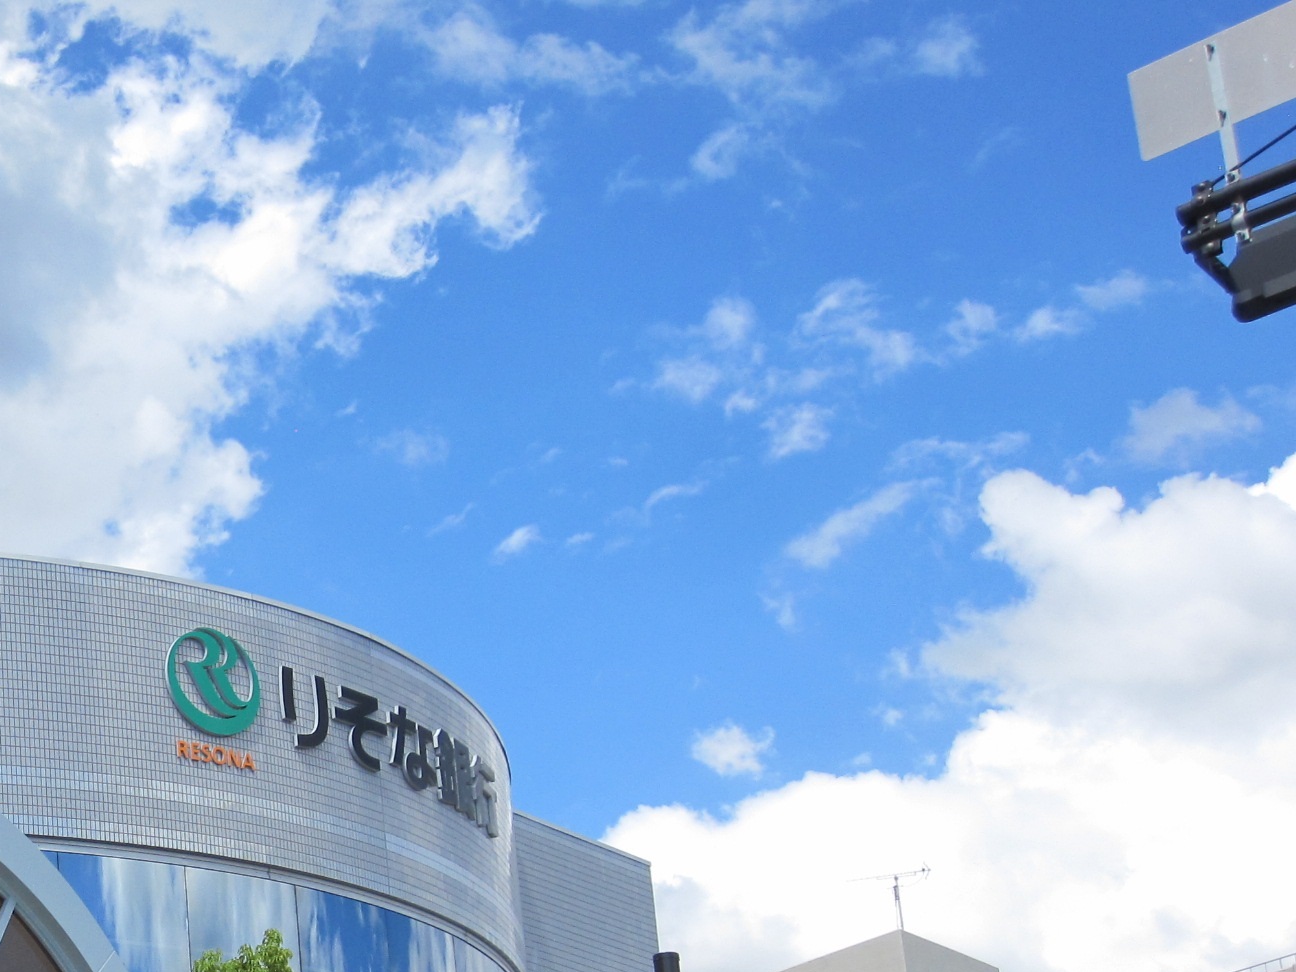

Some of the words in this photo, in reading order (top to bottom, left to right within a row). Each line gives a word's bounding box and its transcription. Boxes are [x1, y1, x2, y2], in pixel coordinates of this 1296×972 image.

[176, 740, 255, 770] RESONA
[279, 665, 498, 838] りそな銀行
